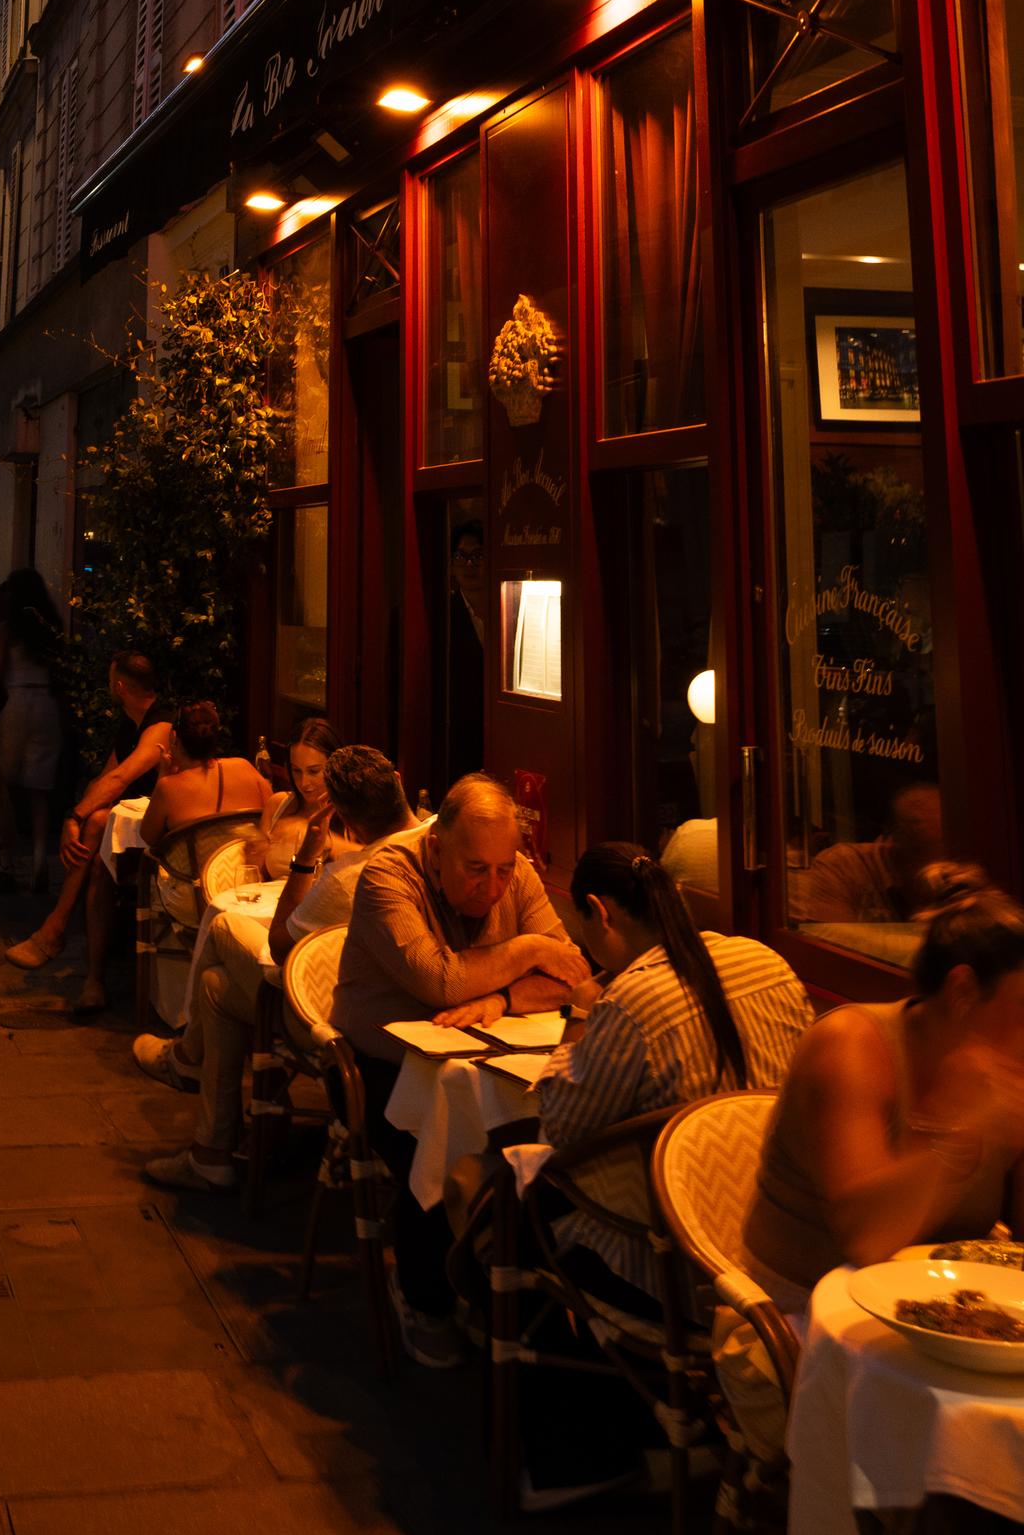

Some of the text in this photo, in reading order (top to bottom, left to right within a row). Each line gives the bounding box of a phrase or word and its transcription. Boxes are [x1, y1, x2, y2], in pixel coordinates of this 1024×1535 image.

[263, 51, 296, 117] Bn
[840, 564, 921, 652] Française
[812, 654, 895, 696] Vins Fins
[789, 709, 924, 763] Produits de saison
